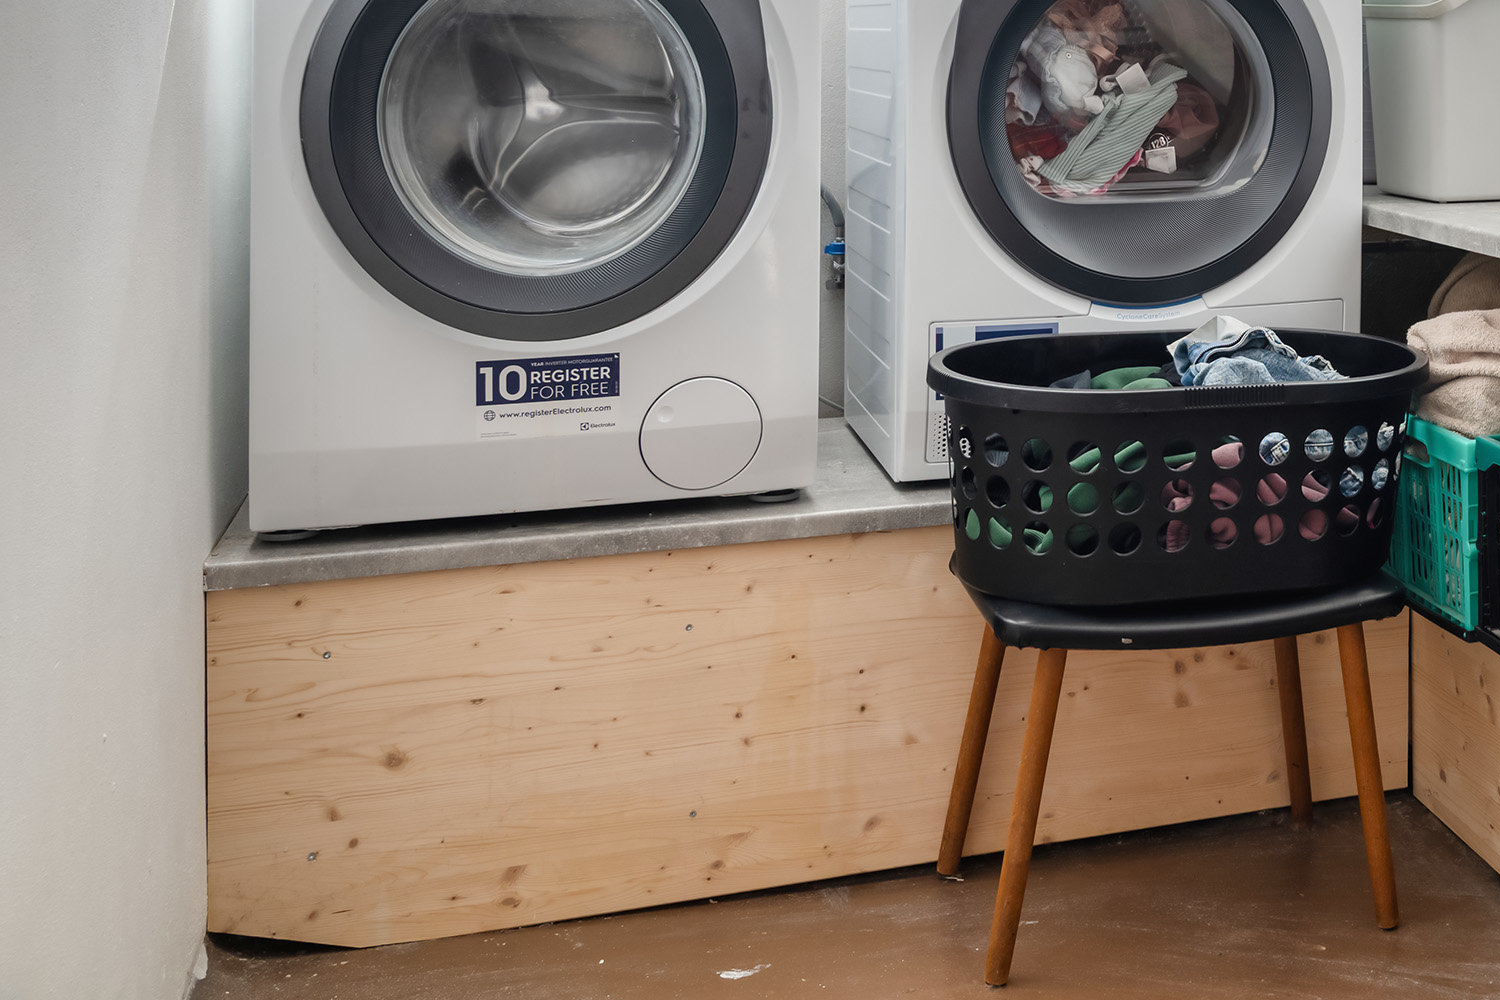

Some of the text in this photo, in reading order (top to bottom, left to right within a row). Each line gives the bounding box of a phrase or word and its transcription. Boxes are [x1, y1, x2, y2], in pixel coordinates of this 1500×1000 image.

[1151, 136, 1166, 149] 128
[1116, 311, 1181, 320] CycloneCareSystem
[530, 366, 611, 384] REGISTER
[480, 365, 527, 402] 10
[531, 385, 565, 400] FOR
[571, 382, 609, 397] FREE
[499, 404, 612, 419] www.registerElectrolux.com
